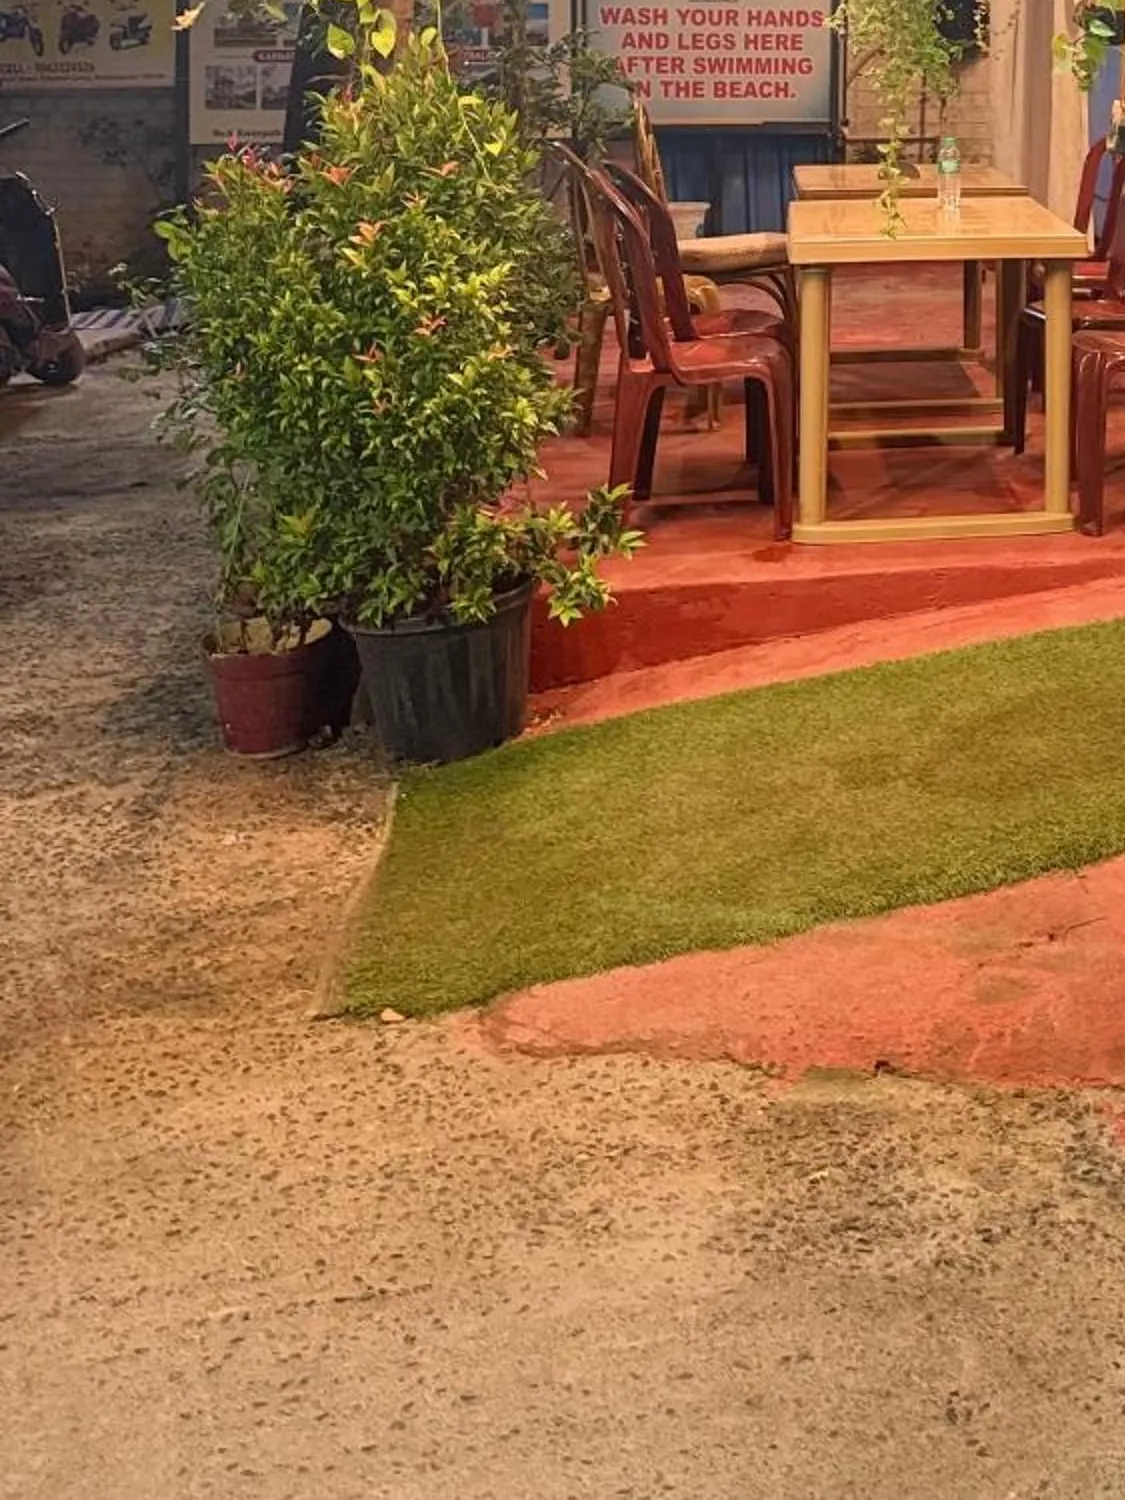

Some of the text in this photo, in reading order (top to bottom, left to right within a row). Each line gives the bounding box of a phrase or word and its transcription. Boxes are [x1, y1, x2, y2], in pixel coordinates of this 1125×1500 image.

[600, 7, 825, 28] WASH YOUR HANDS
[621, 31, 804, 51] AND LEGS HERE
[692, 57, 814, 75] SWIMMING
[634, 80, 797, 99] N THE BEACH.
